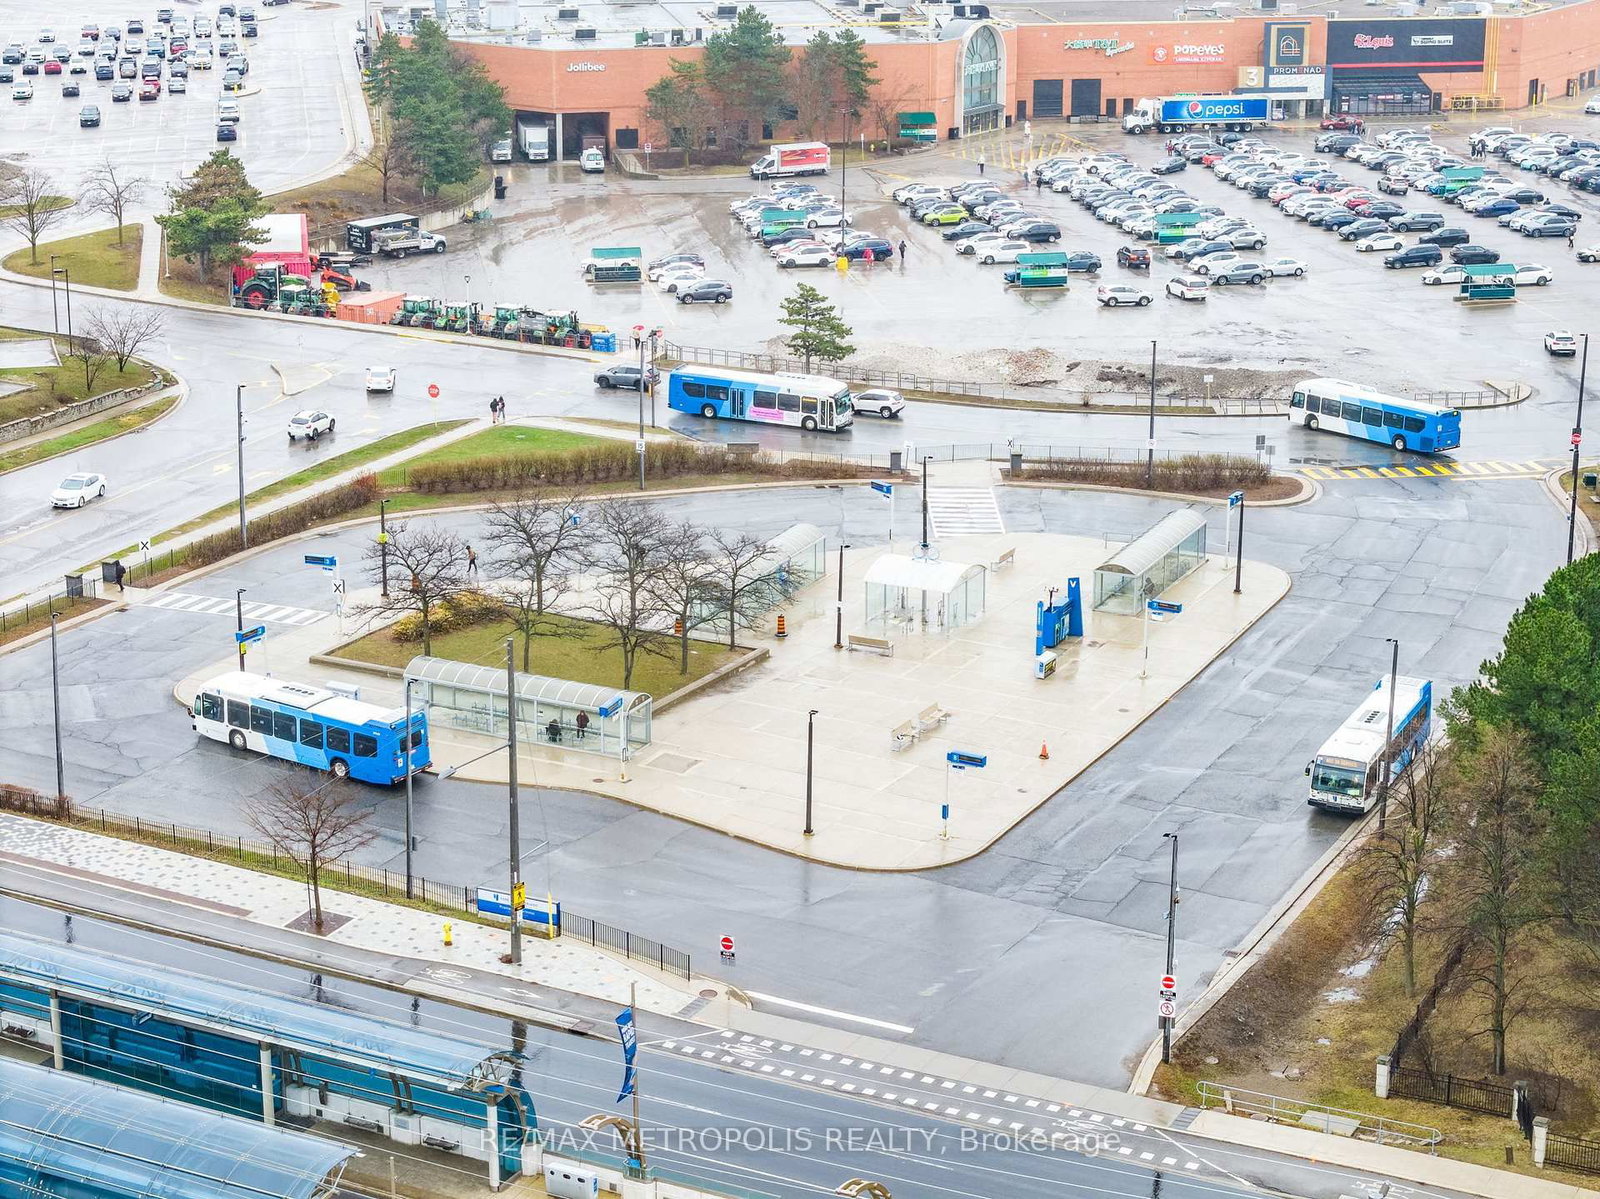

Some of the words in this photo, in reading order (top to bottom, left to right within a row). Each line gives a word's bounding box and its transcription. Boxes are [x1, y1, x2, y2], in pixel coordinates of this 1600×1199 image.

[1174, 43, 1224, 55] POPEYES
[567, 62, 606, 72] Jollibee
[1246, 67, 1258, 86] 3
[1205, 102, 1244, 117] pepsi
